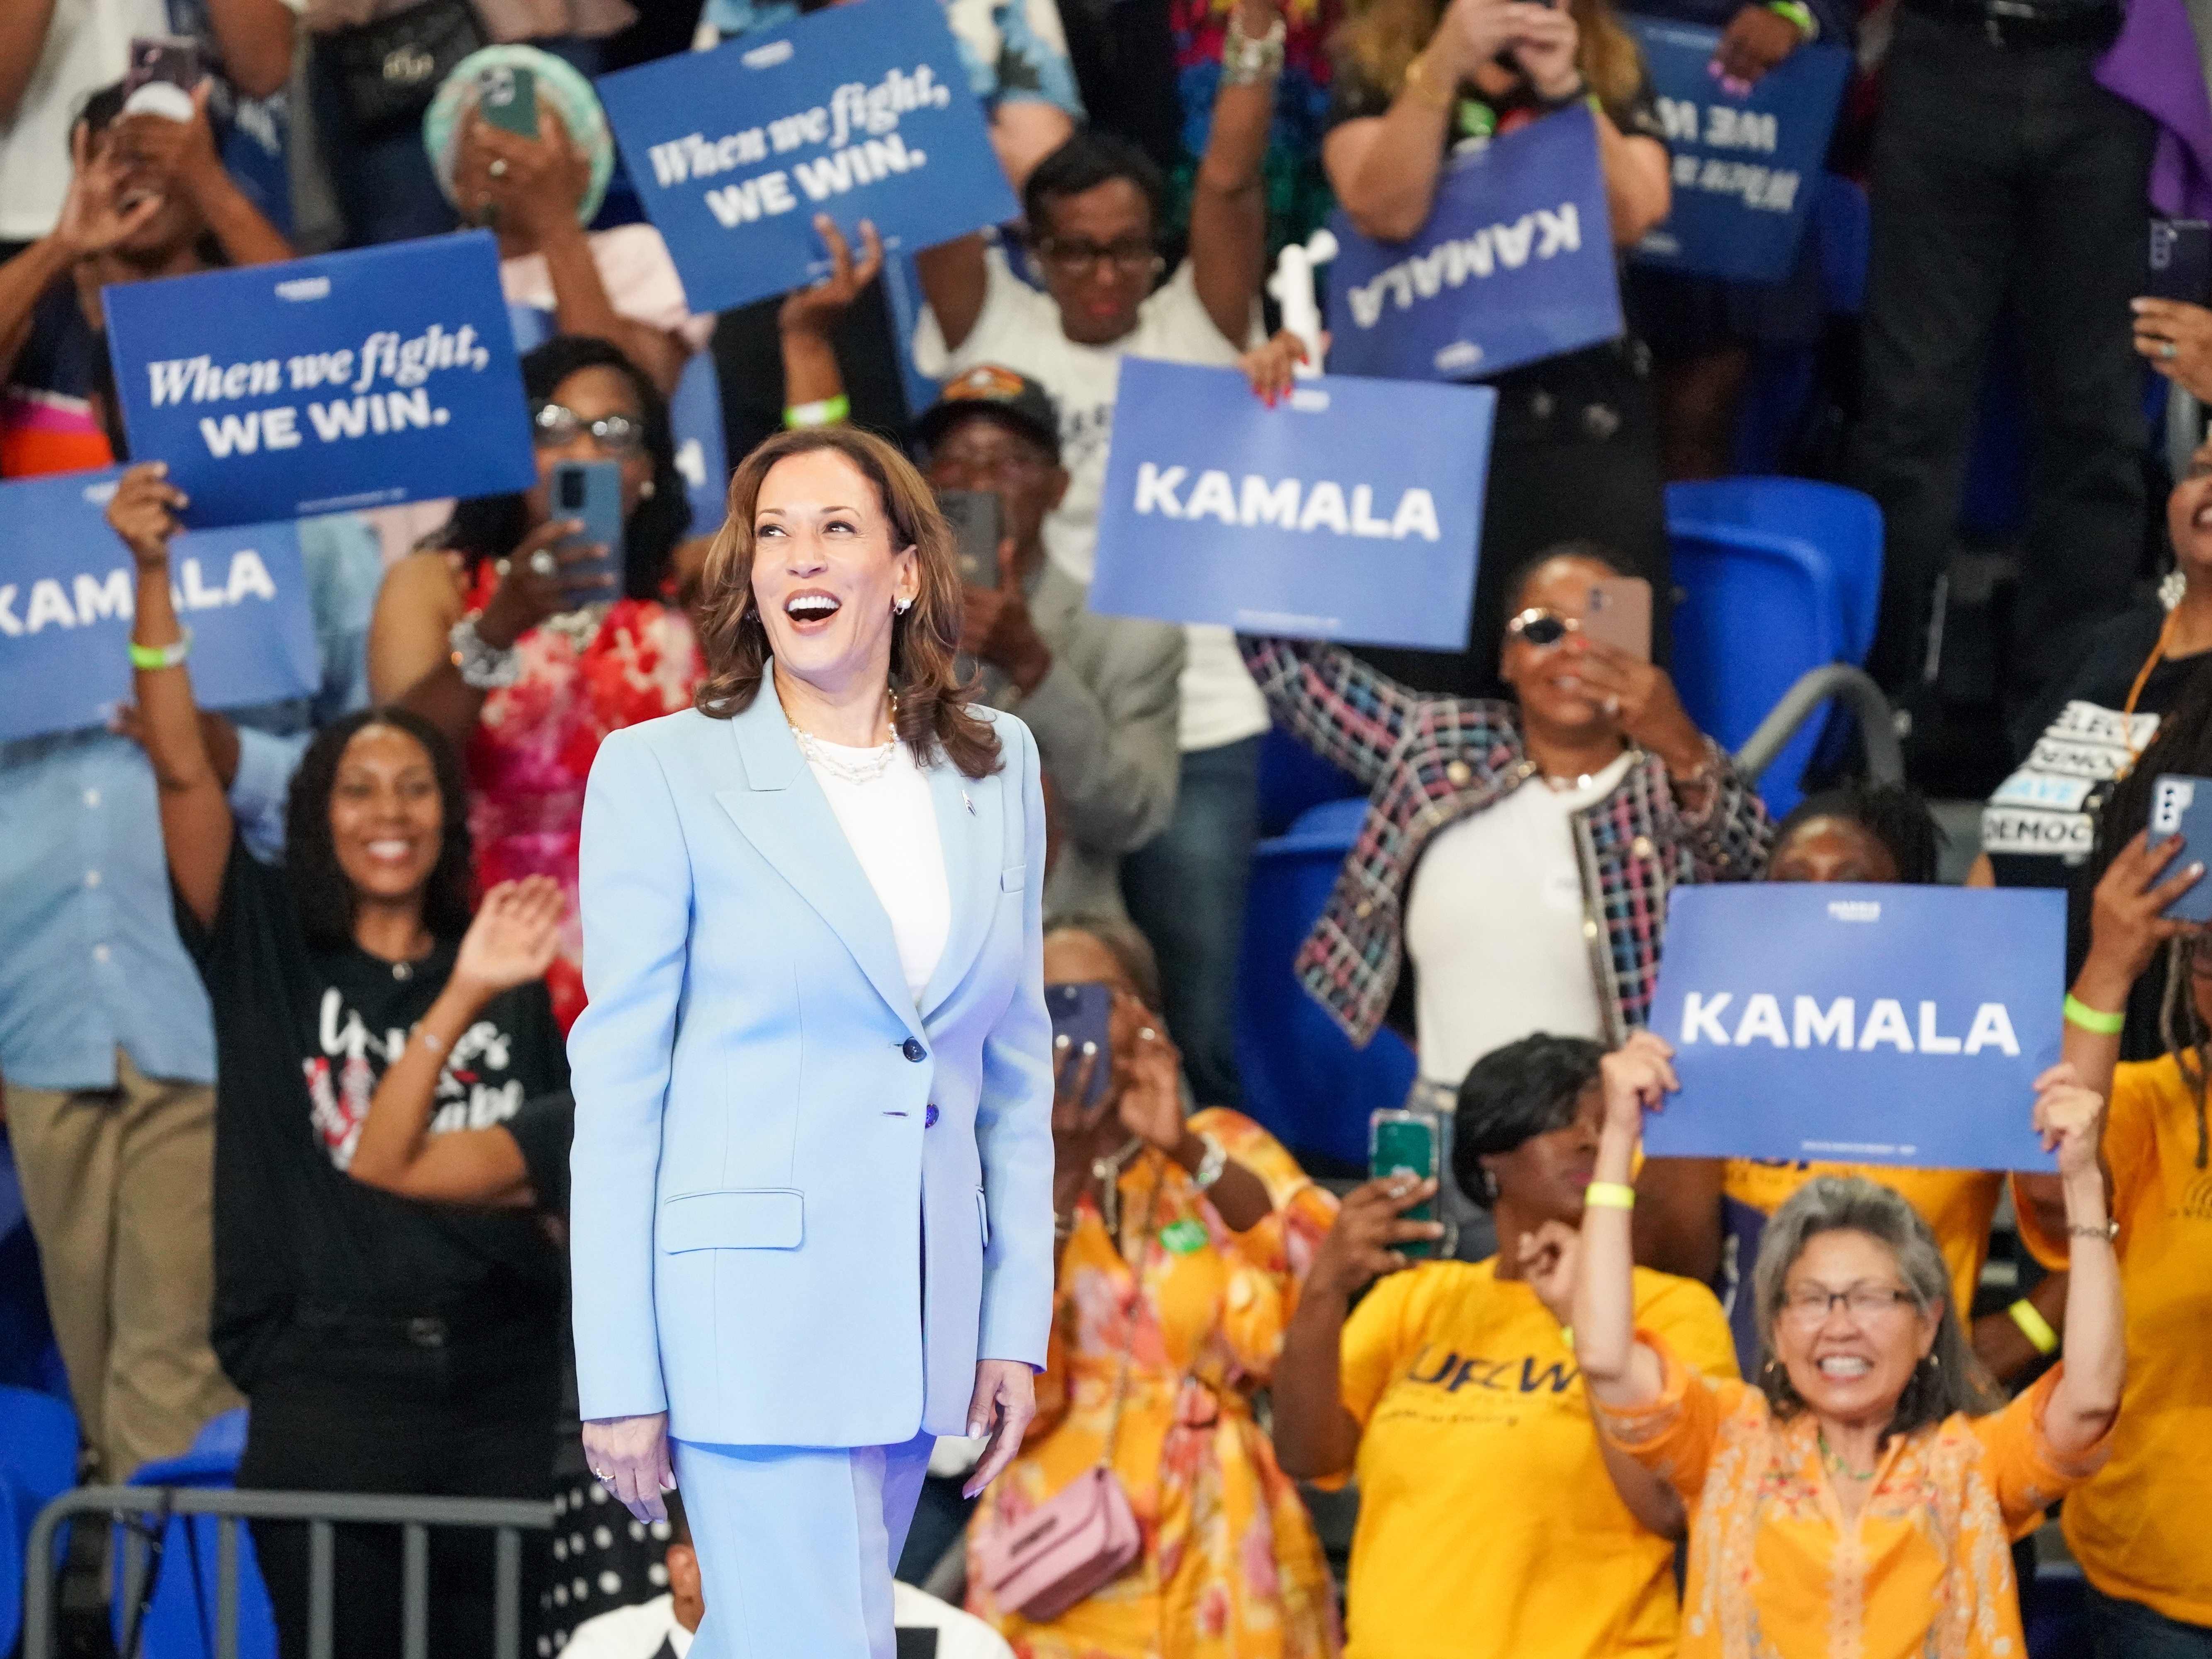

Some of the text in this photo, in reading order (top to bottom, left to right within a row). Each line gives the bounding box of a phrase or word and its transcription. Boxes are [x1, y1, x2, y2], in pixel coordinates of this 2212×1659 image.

[649, 64, 950, 186] When we fight,
[706, 133, 926, 227] WE WIN.
[1350, 203, 1581, 326] KAMALA
[148, 324, 489, 406] When we fight,
[200, 387, 450, 457] WE WIN.
[1135, 463, 1440, 541] KAMALA
[0, 550, 275, 635] KAMLA
[1680, 991, 2020, 1056] KAMALA
